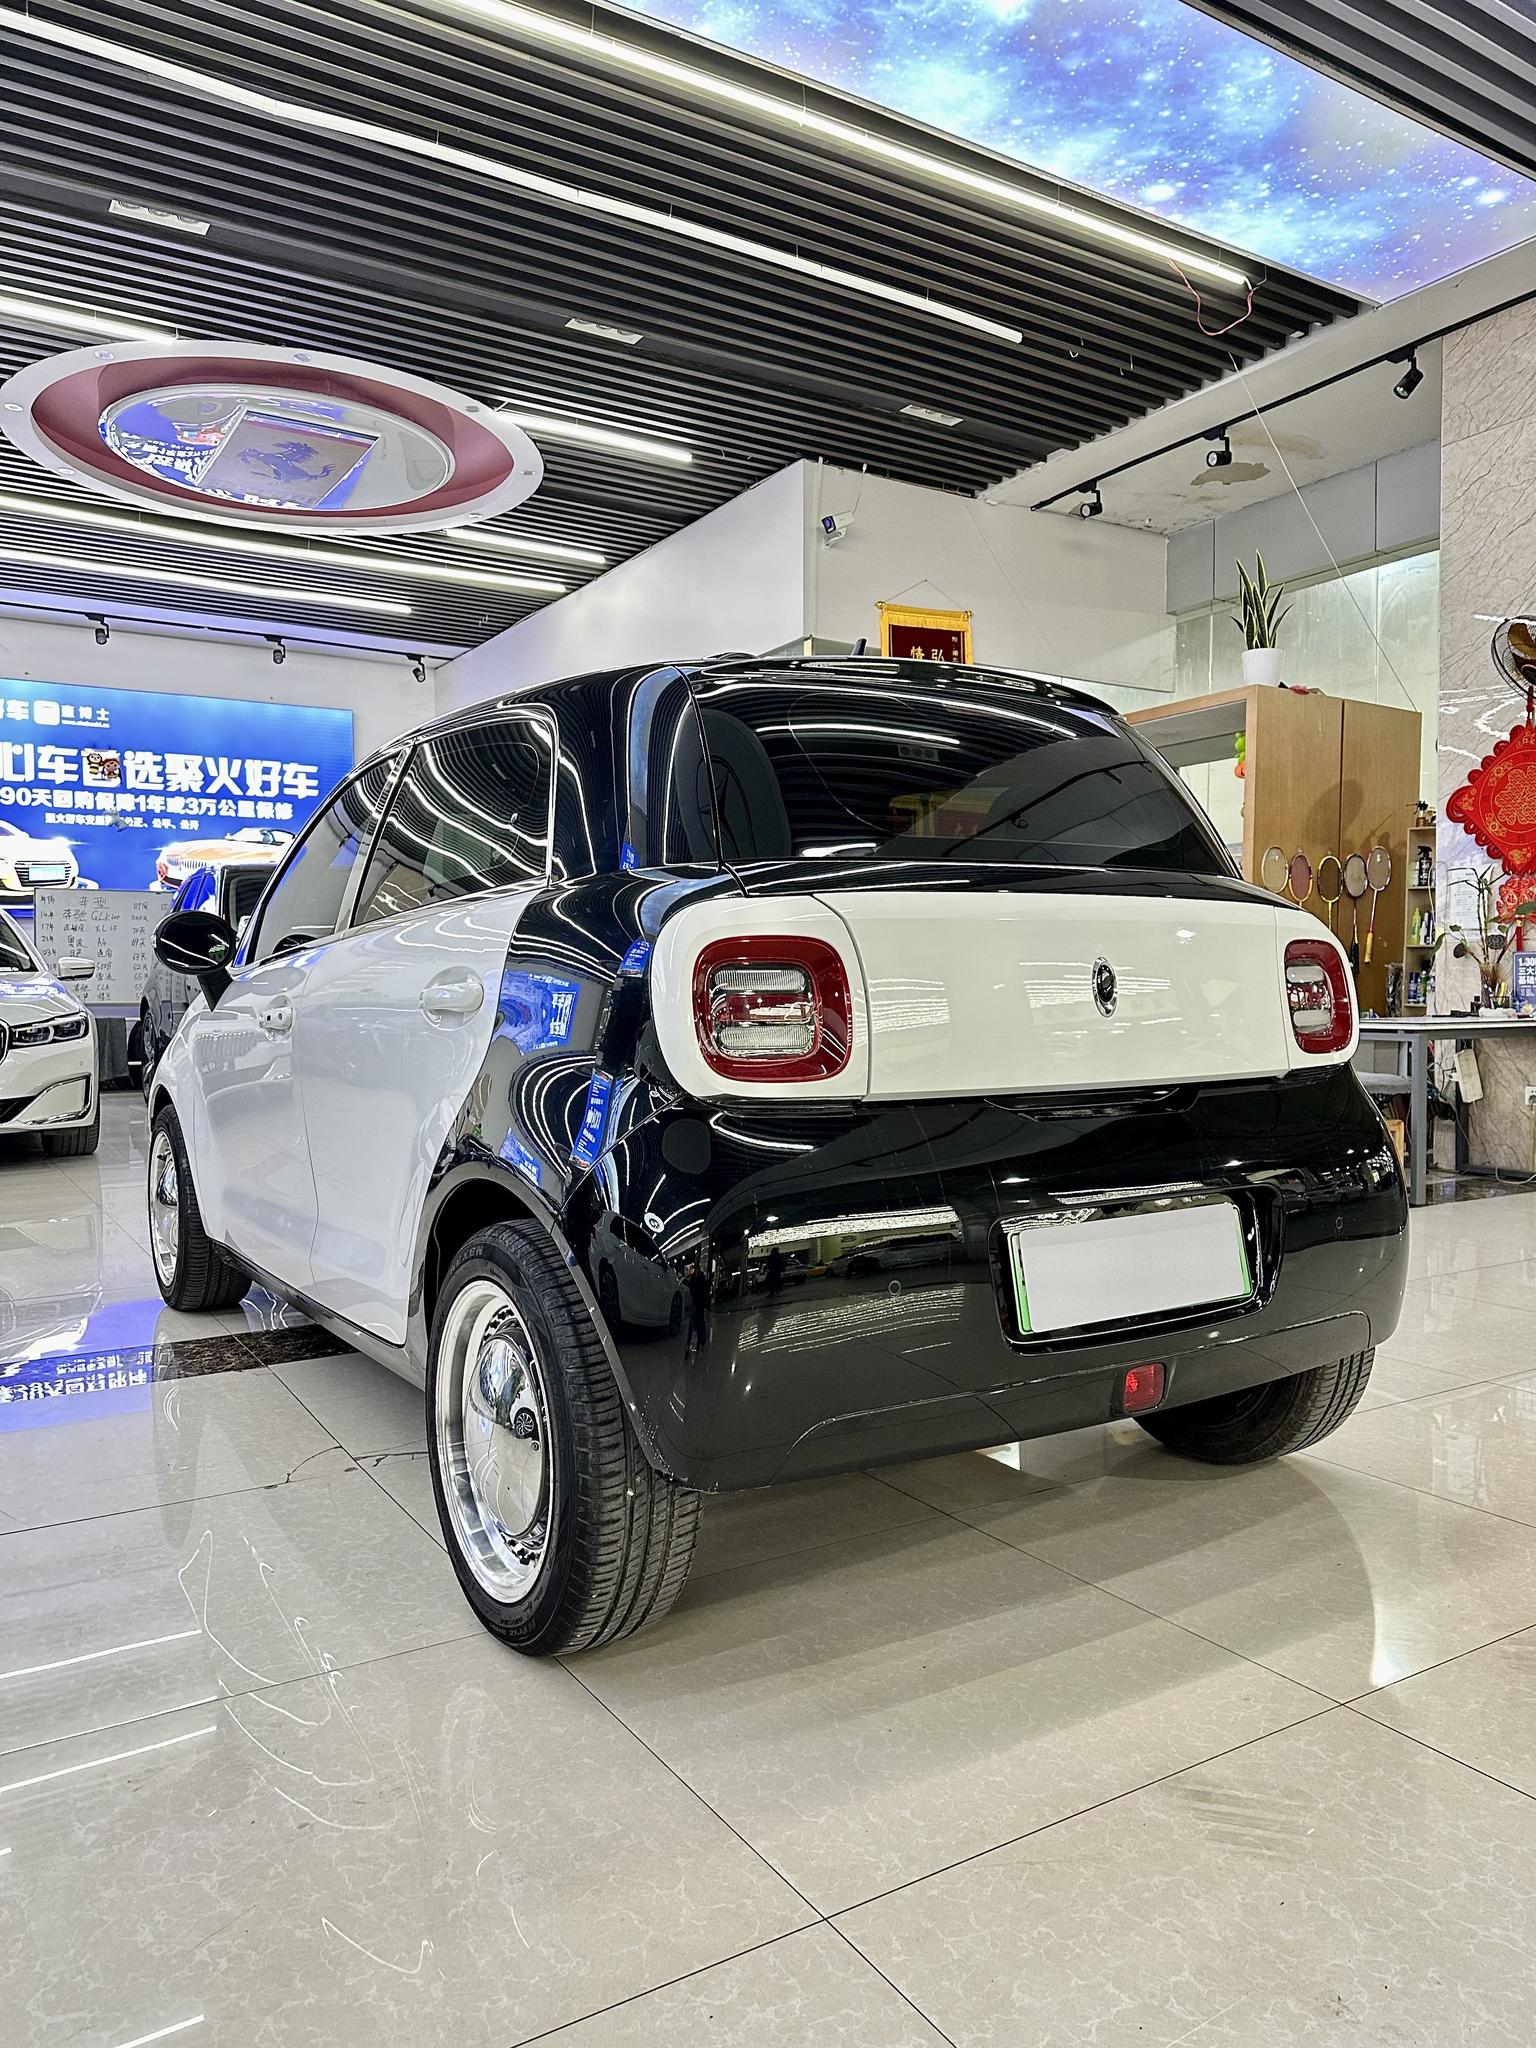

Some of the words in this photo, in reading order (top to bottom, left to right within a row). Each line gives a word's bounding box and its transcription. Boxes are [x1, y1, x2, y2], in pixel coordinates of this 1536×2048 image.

[0, 698, 29, 721] 车
[1518, 966, 1536, 976] 三大
[1518, 975, 1536, 985] 基础
